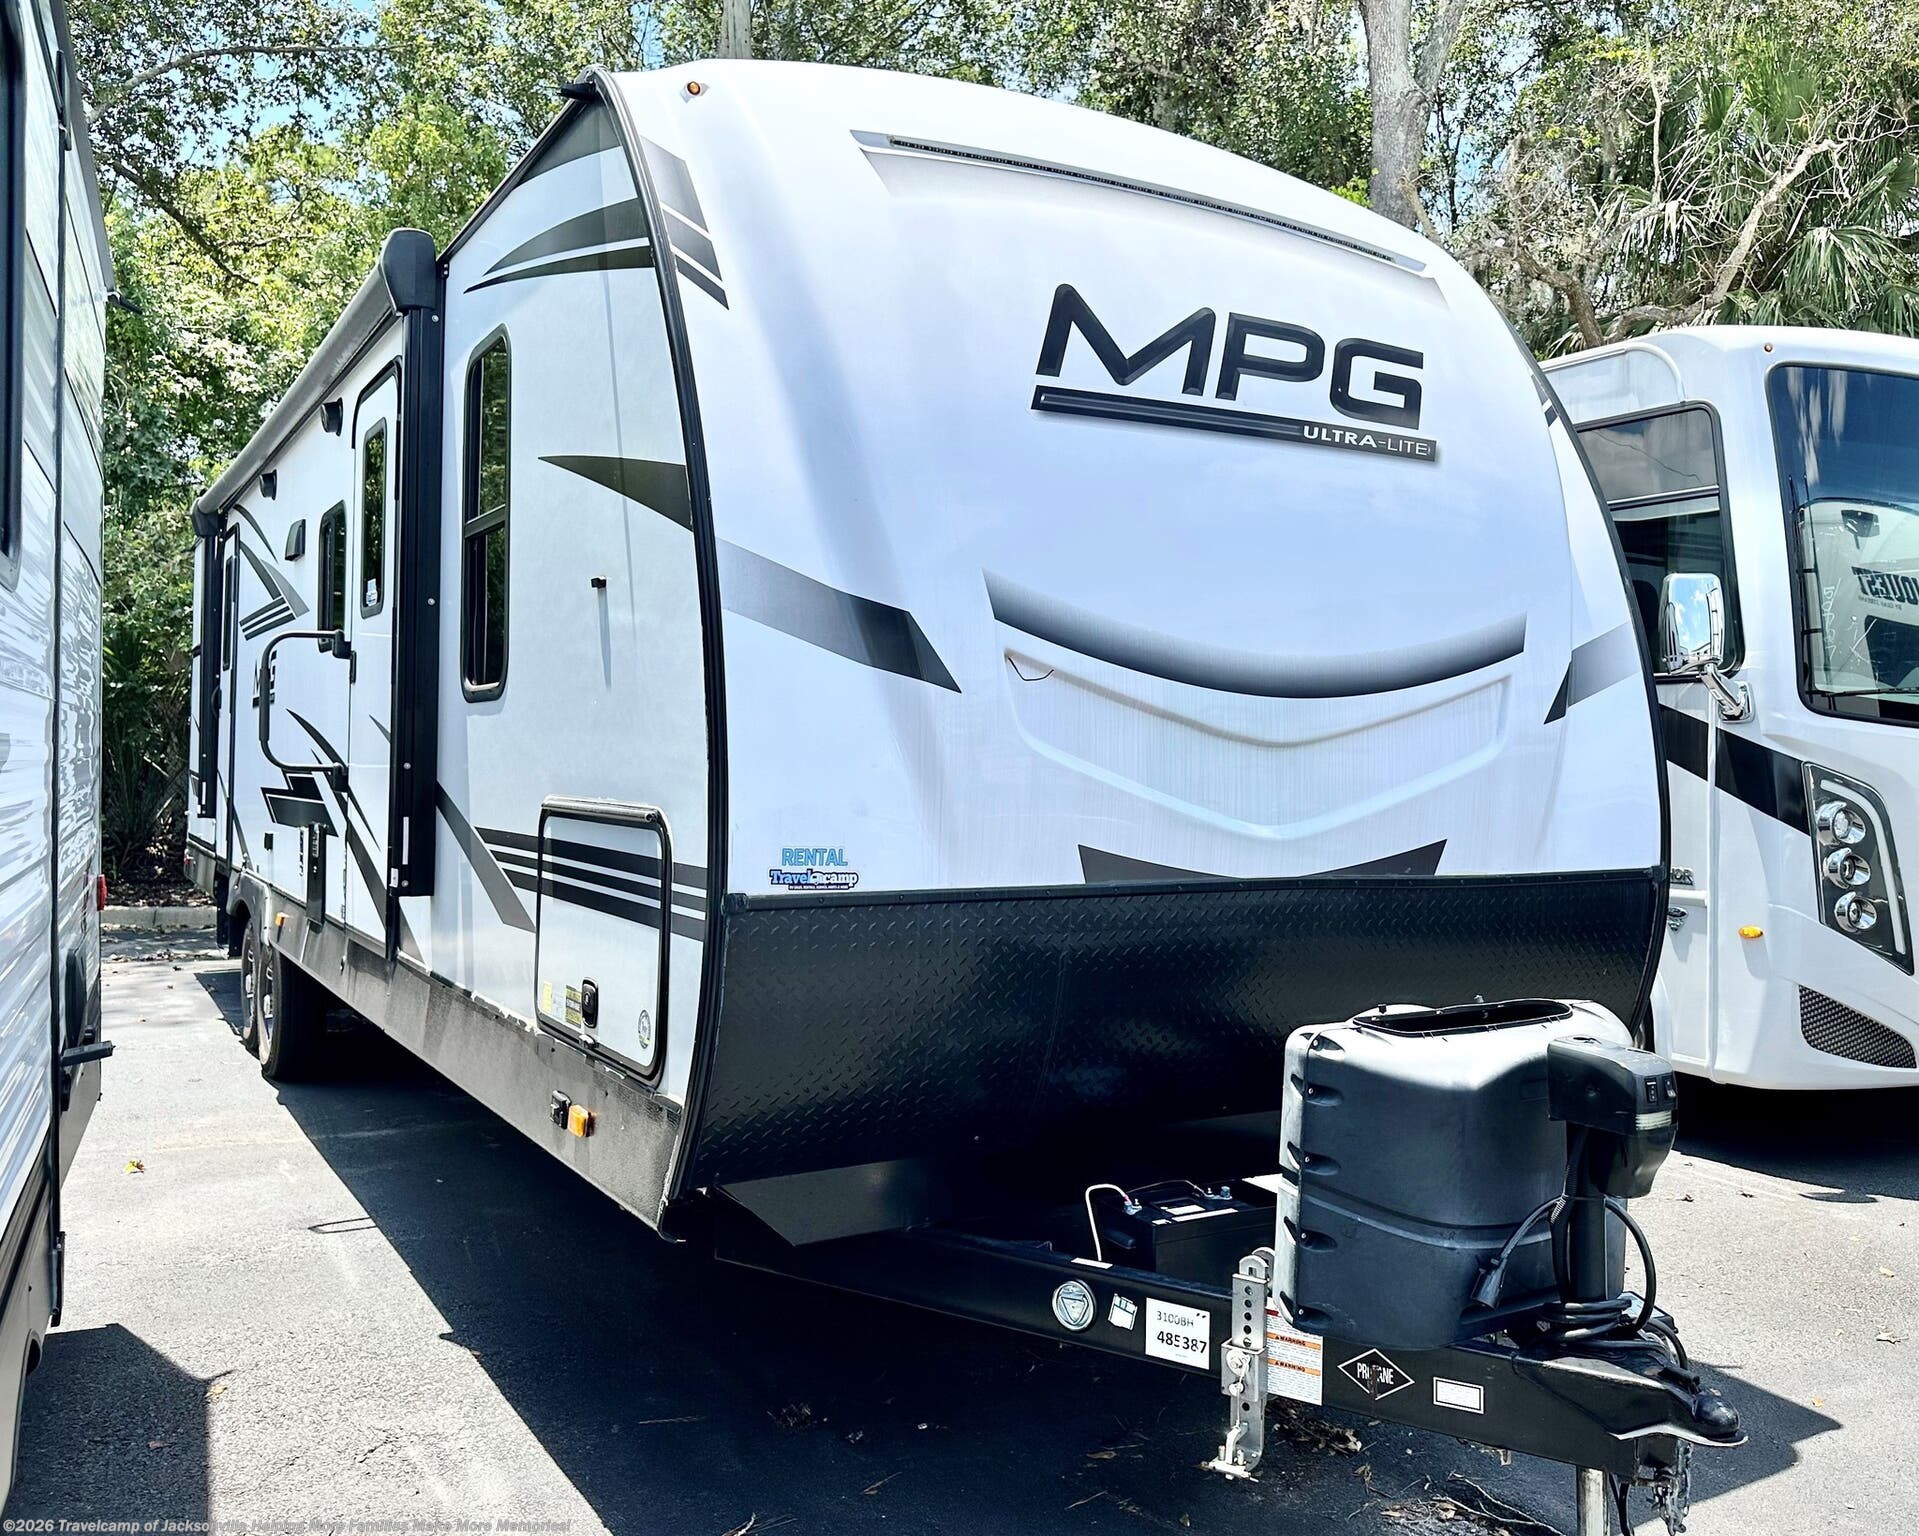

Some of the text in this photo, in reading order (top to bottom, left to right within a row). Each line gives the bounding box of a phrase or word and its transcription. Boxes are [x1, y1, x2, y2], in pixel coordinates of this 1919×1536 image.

[1036, 284, 1424, 430] MPG
[1303, 425, 1428, 456] ULTRA-LITE
[781, 848, 848, 866] RENTAL
[1157, 1331, 1207, 1354] 485387
[1280, 1335, 1306, 1346] WARNING
[1357, 1362, 1394, 1385] PRANE
